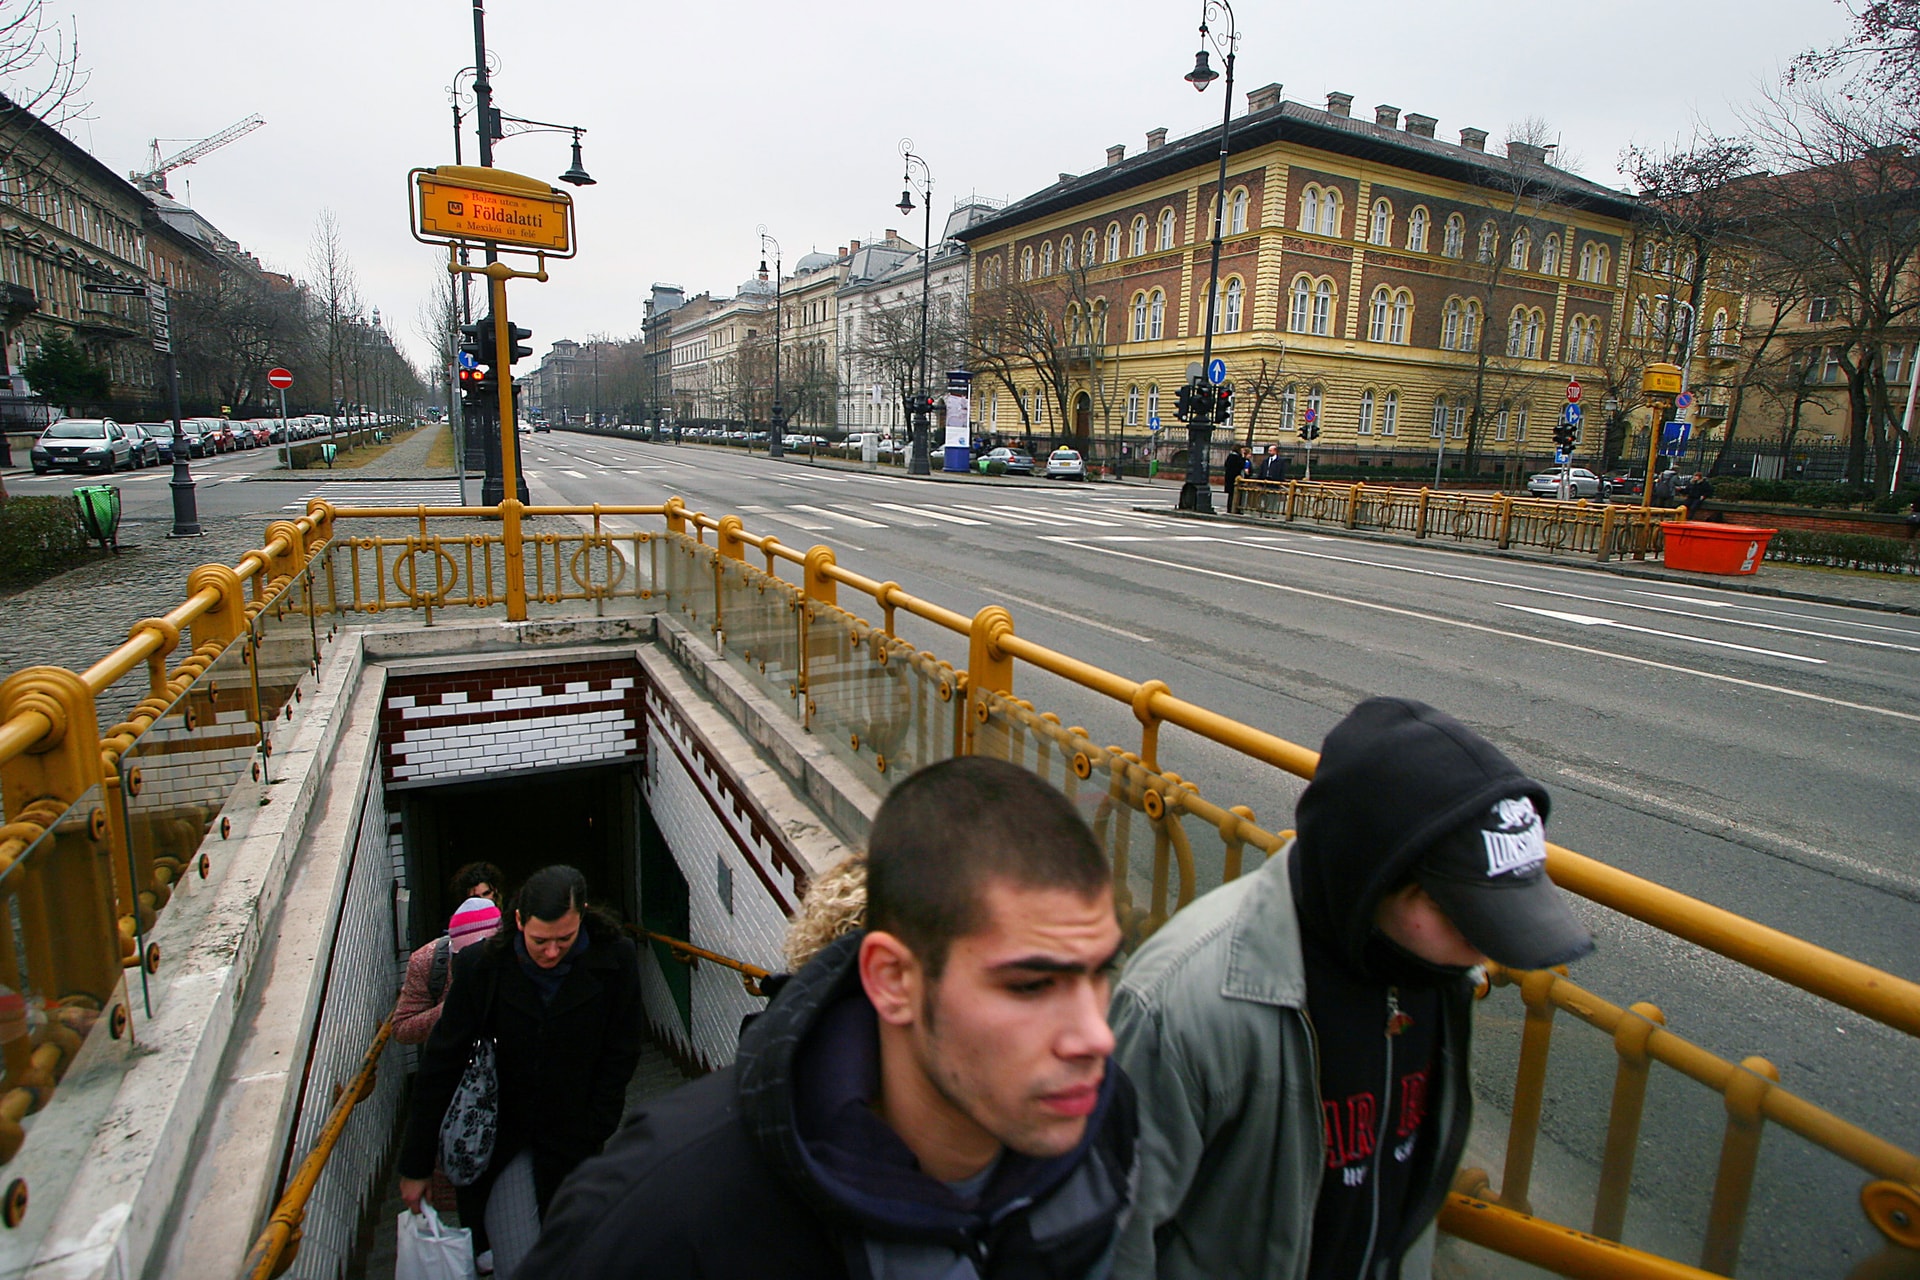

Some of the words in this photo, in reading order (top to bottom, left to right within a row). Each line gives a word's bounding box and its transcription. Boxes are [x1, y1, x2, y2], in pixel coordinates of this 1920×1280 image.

[472, 193, 497, 204] Bajza
[500, 199, 519, 208] utca
[473, 204, 543, 228] Földalatti
[467, 221, 502, 234] Mexikói
[507, 228, 516, 237] út
[520, 229, 536, 239] felé
[1568, 387, 1579, 398] STOP
